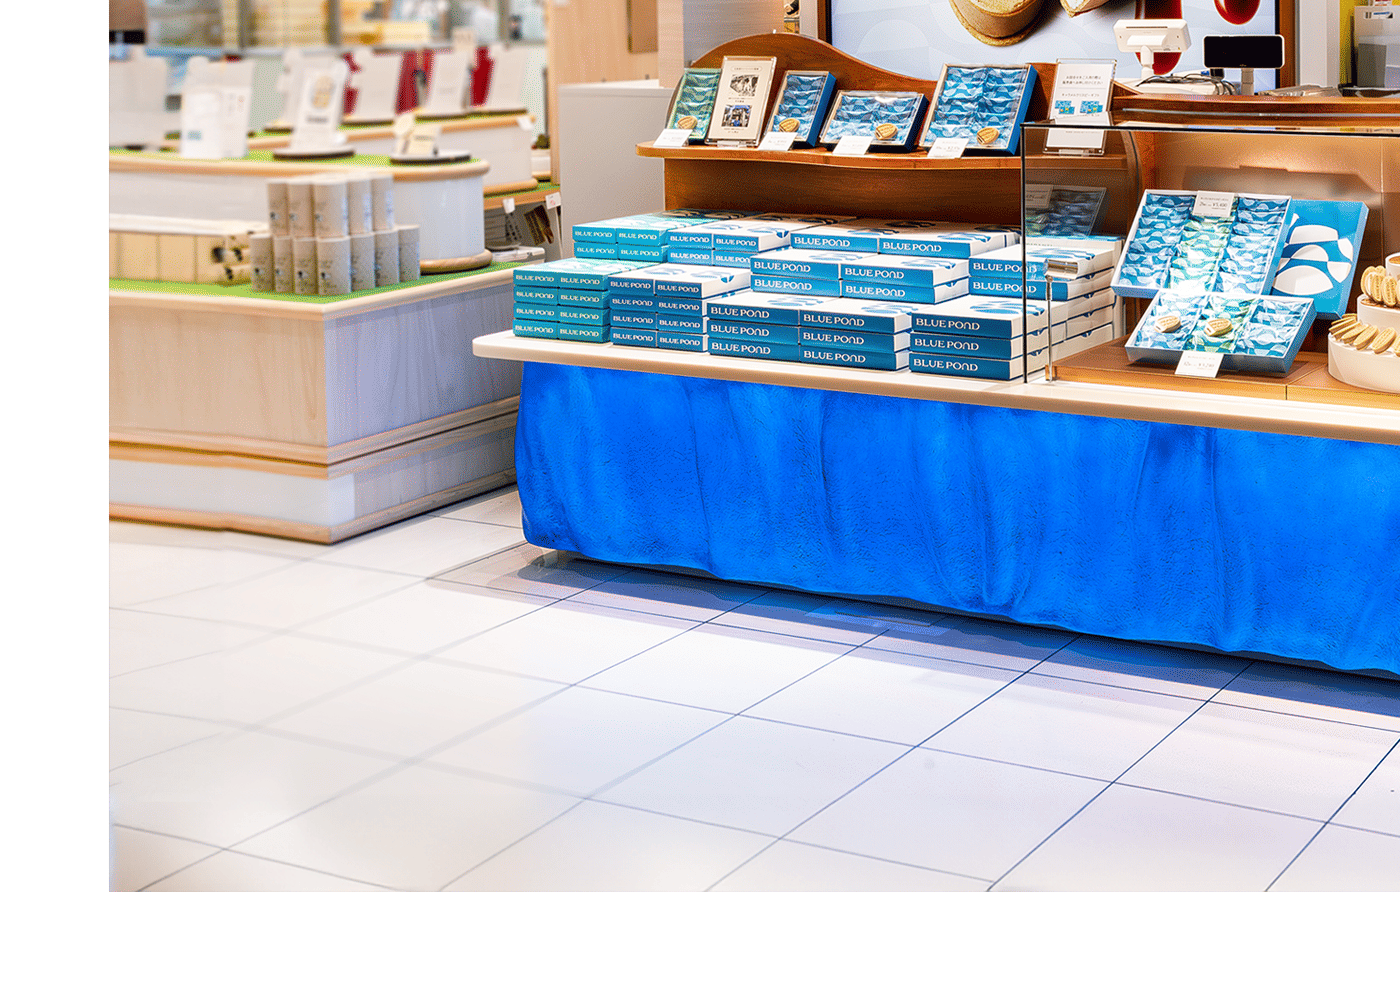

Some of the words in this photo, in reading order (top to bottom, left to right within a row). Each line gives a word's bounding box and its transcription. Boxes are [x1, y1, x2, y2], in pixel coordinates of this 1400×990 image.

[794, 236, 821, 245] BLUE
[822, 238, 850, 247] POND
[883, 241, 911, 250] BLUE
[912, 243, 942, 253] POND
[754, 261, 782, 270] BLUE
[783, 263, 811, 273] POND
[845, 267, 873, 276] BLUE
[874, 270, 905, 279] POND
[657, 284, 677, 292] BLUE
[754, 279, 782, 288] BLUE
[784, 281, 812, 291] POND
[845, 285, 874, 294] BLUE
[875, 287, 906, 297] POND
[710, 306, 739, 316] BLUE
[740, 308, 770, 318] POND
[613, 315, 632, 323] BLUE
[659, 319, 679, 327] BLUE
[803, 313, 833, 324] BLUE
[834, 316, 865, 327] POND
[915, 318, 946, 328] BLUE
[948, 320, 981, 330] POND
[710, 324, 739, 334] BLUE
[740, 326, 770, 337] POND
[803, 332, 833, 342] BLUE
[834, 334, 865, 345] POND
[914, 338, 946, 348] BLUE
[947, 341, 980, 351] POND
[711, 342, 740, 352] BLUE
[741, 344, 771, 355] POND
[803, 350, 834, 360] BLUE
[834, 352, 866, 363] POND
[913, 358, 945, 368] BLUE
[945, 361, 979, 372] POND
